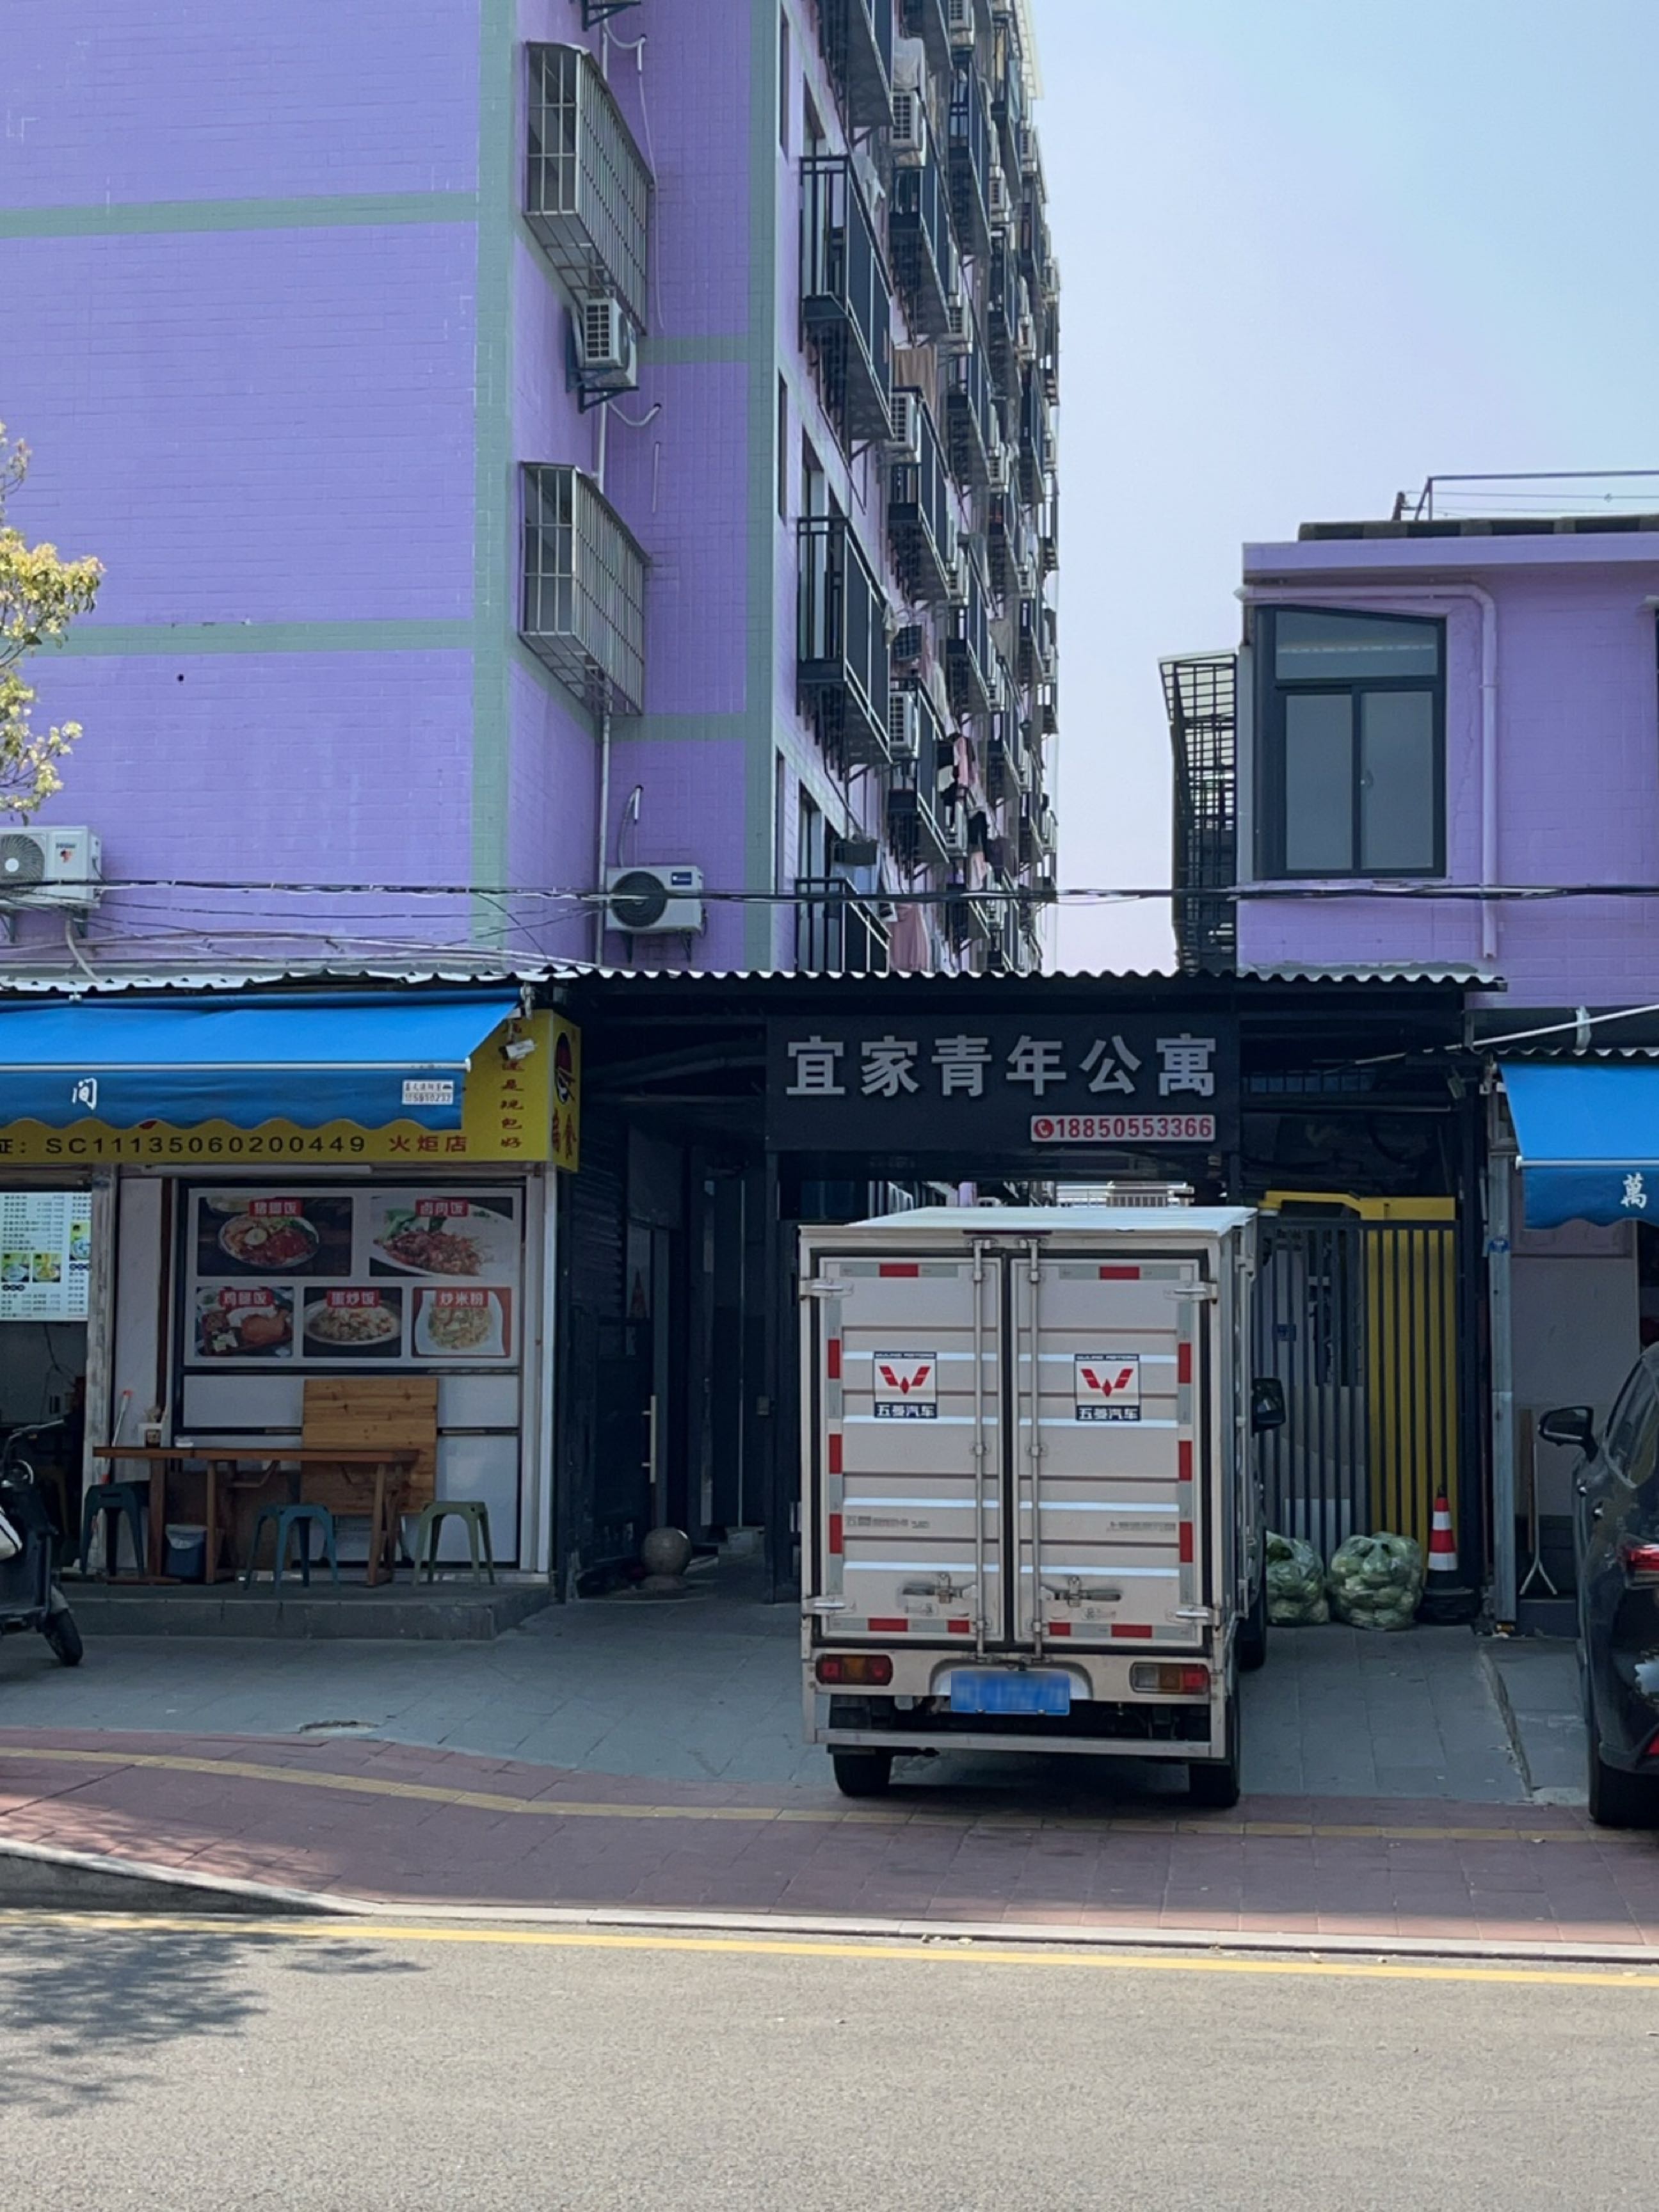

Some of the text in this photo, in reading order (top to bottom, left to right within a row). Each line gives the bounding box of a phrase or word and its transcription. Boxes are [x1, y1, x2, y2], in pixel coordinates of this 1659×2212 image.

[787, 1034, 1216, 1097] 宜家青年公寓
[1056, 1118, 1212, 1139] 18850553366
[389, 1135, 467, 1153] 火炬店
[1621, 1171, 1647, 1209] 萬
[420, 1201, 463, 1216] 卤肉饭
[440, 1290, 484, 1306] 炒米粉
[877, 1404, 935, 1417] 五菱汽车
[1078, 1407, 1139, 1420] 五菱汽车
